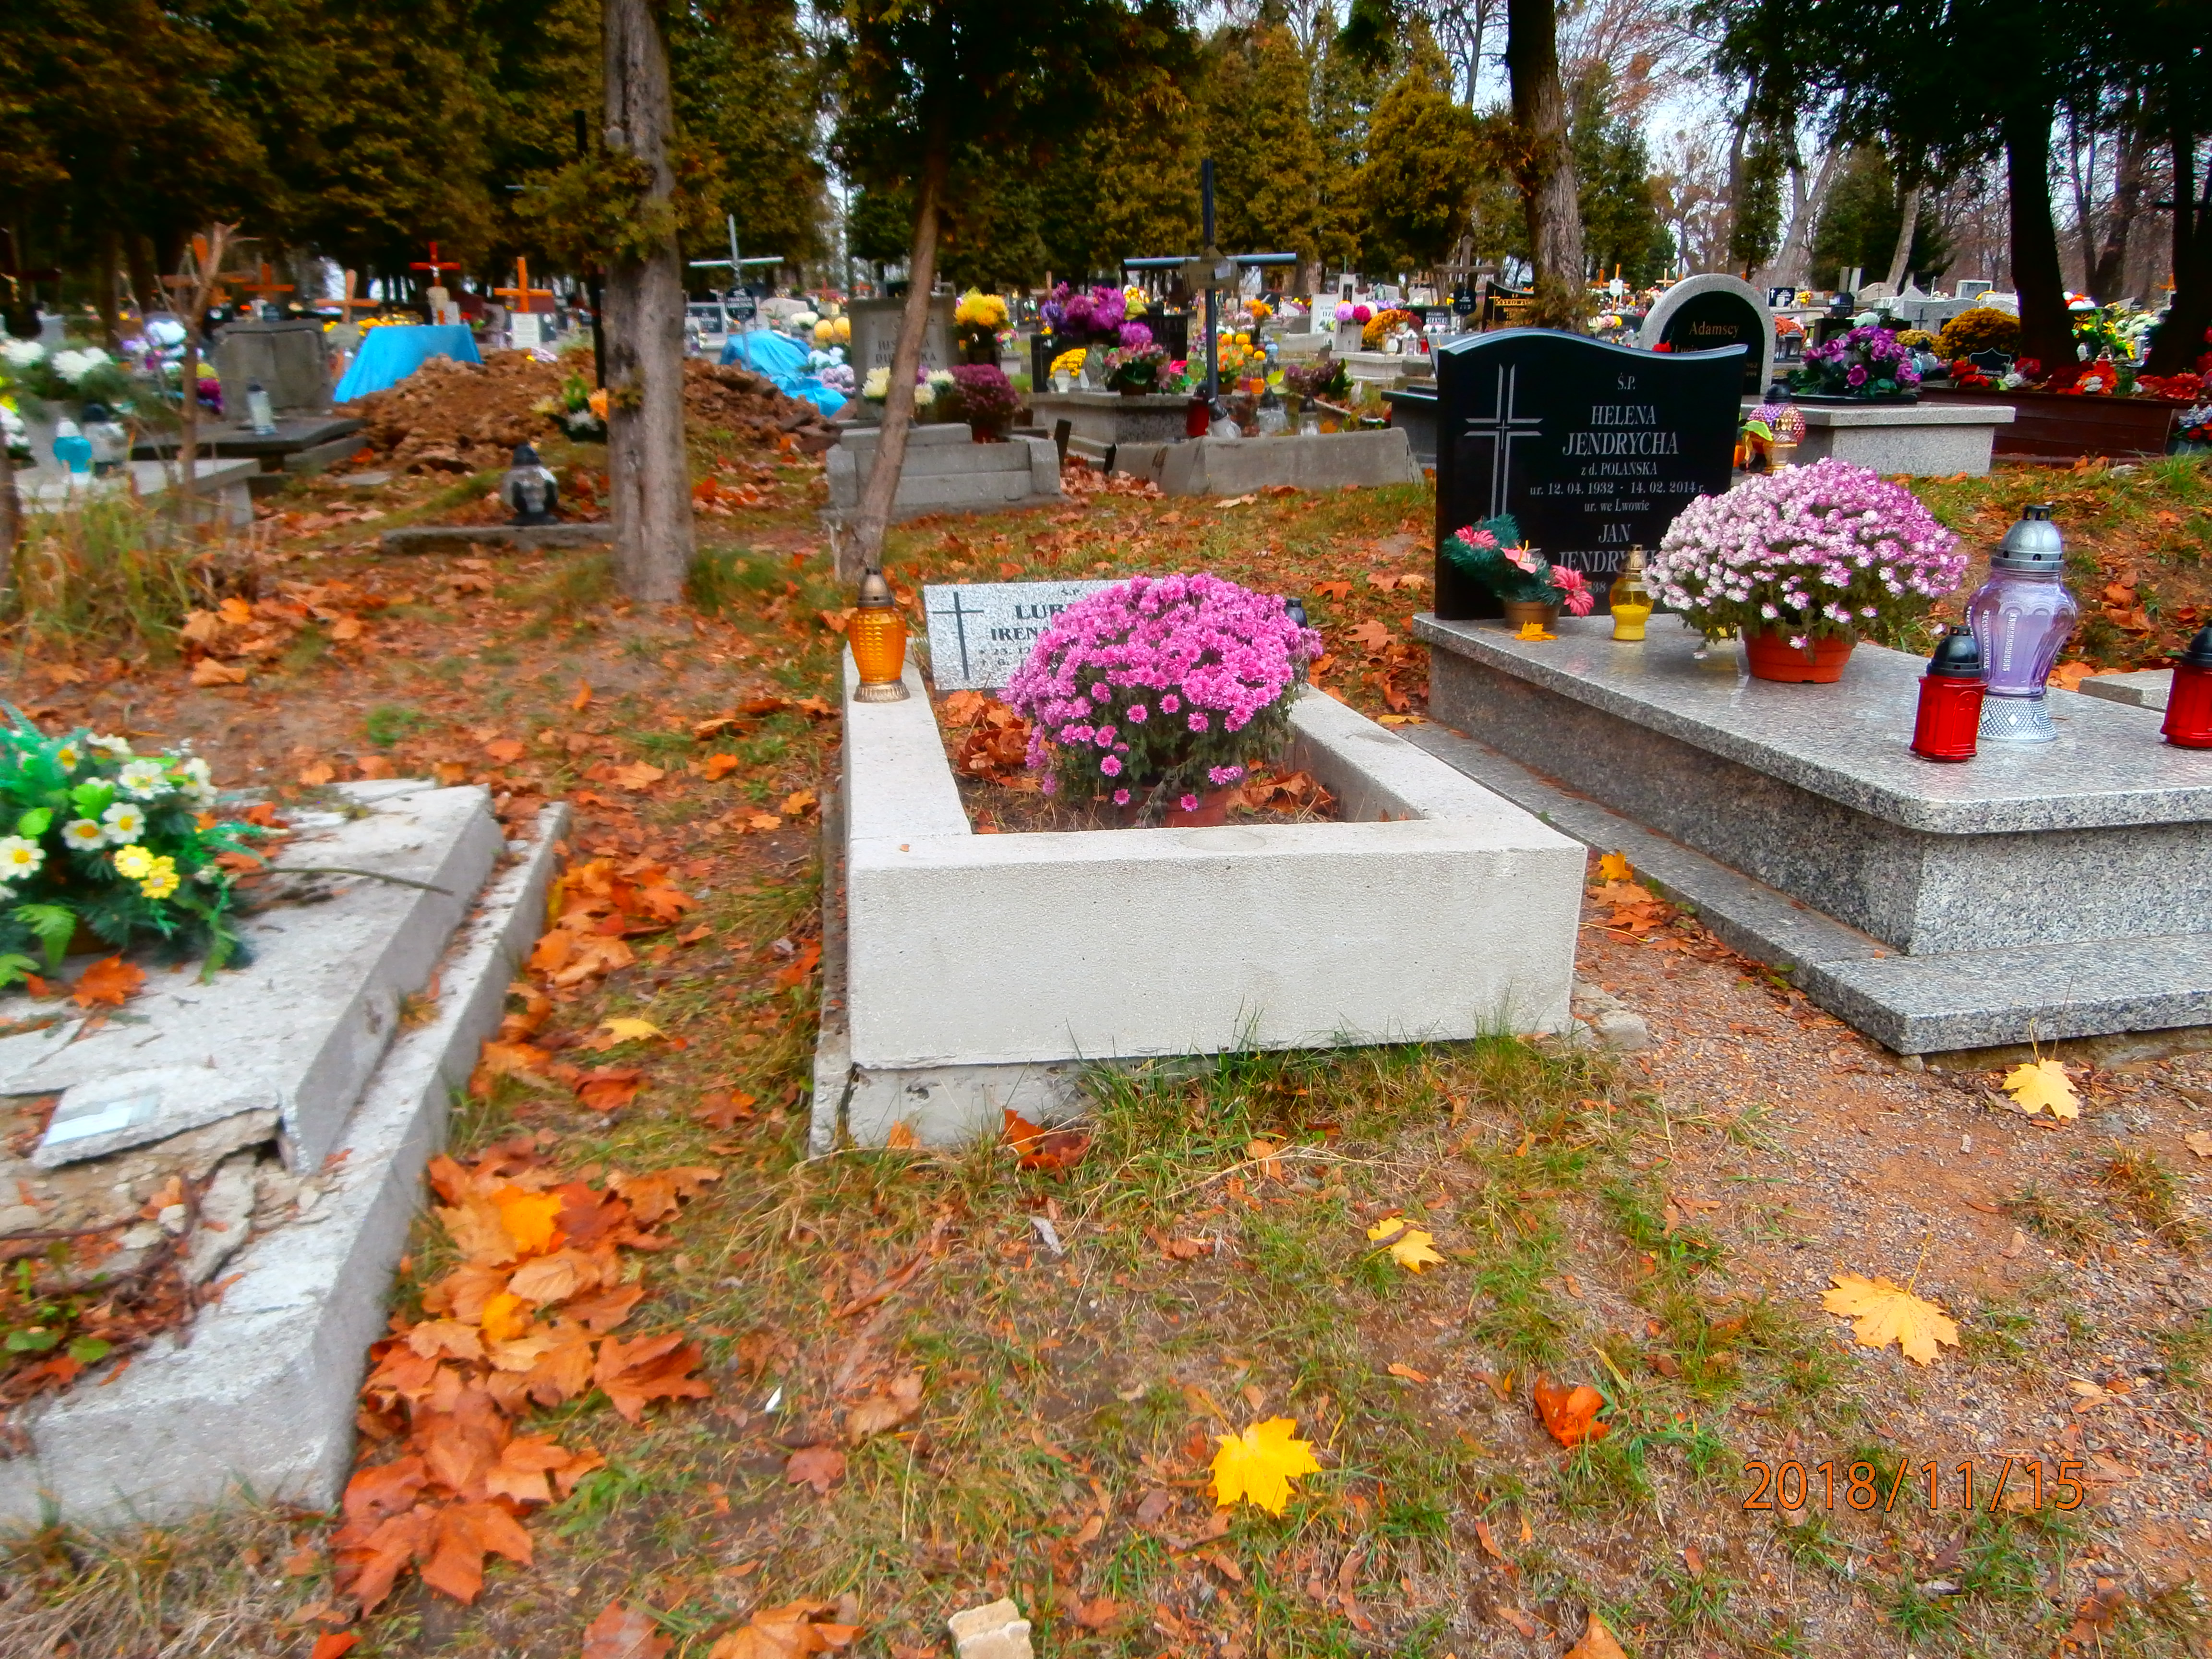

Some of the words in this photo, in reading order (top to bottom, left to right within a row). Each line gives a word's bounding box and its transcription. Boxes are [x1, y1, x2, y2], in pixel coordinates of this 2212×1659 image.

[1689, 321, 1740, 338] Adamscy
[1618, 372, 1636, 390] Ś.P.
[1590, 405, 1657, 426] HELENA
[1562, 432, 1680, 457] JENDRYCHA
[1581, 467, 1586, 476] z
[1588, 462, 1598, 476] d.
[1530, 486, 1544, 495] ur.
[1548, 482, 1563, 495] 12.
[1567, 482, 1584, 495] 04.
[1588, 481, 1614, 494] 1932
[1631, 481, 1646, 494] 14.
[1649, 481, 1666, 493] 02.
[1669, 481, 1696, 493] 2014
[1698, 484, 1705, 493] r.
[1584, 503, 1597, 512] ur.
[1600, 503, 1612, 512] we
[1614, 498, 1650, 512] Lwowie
[1598, 523, 1632, 543] JAN
